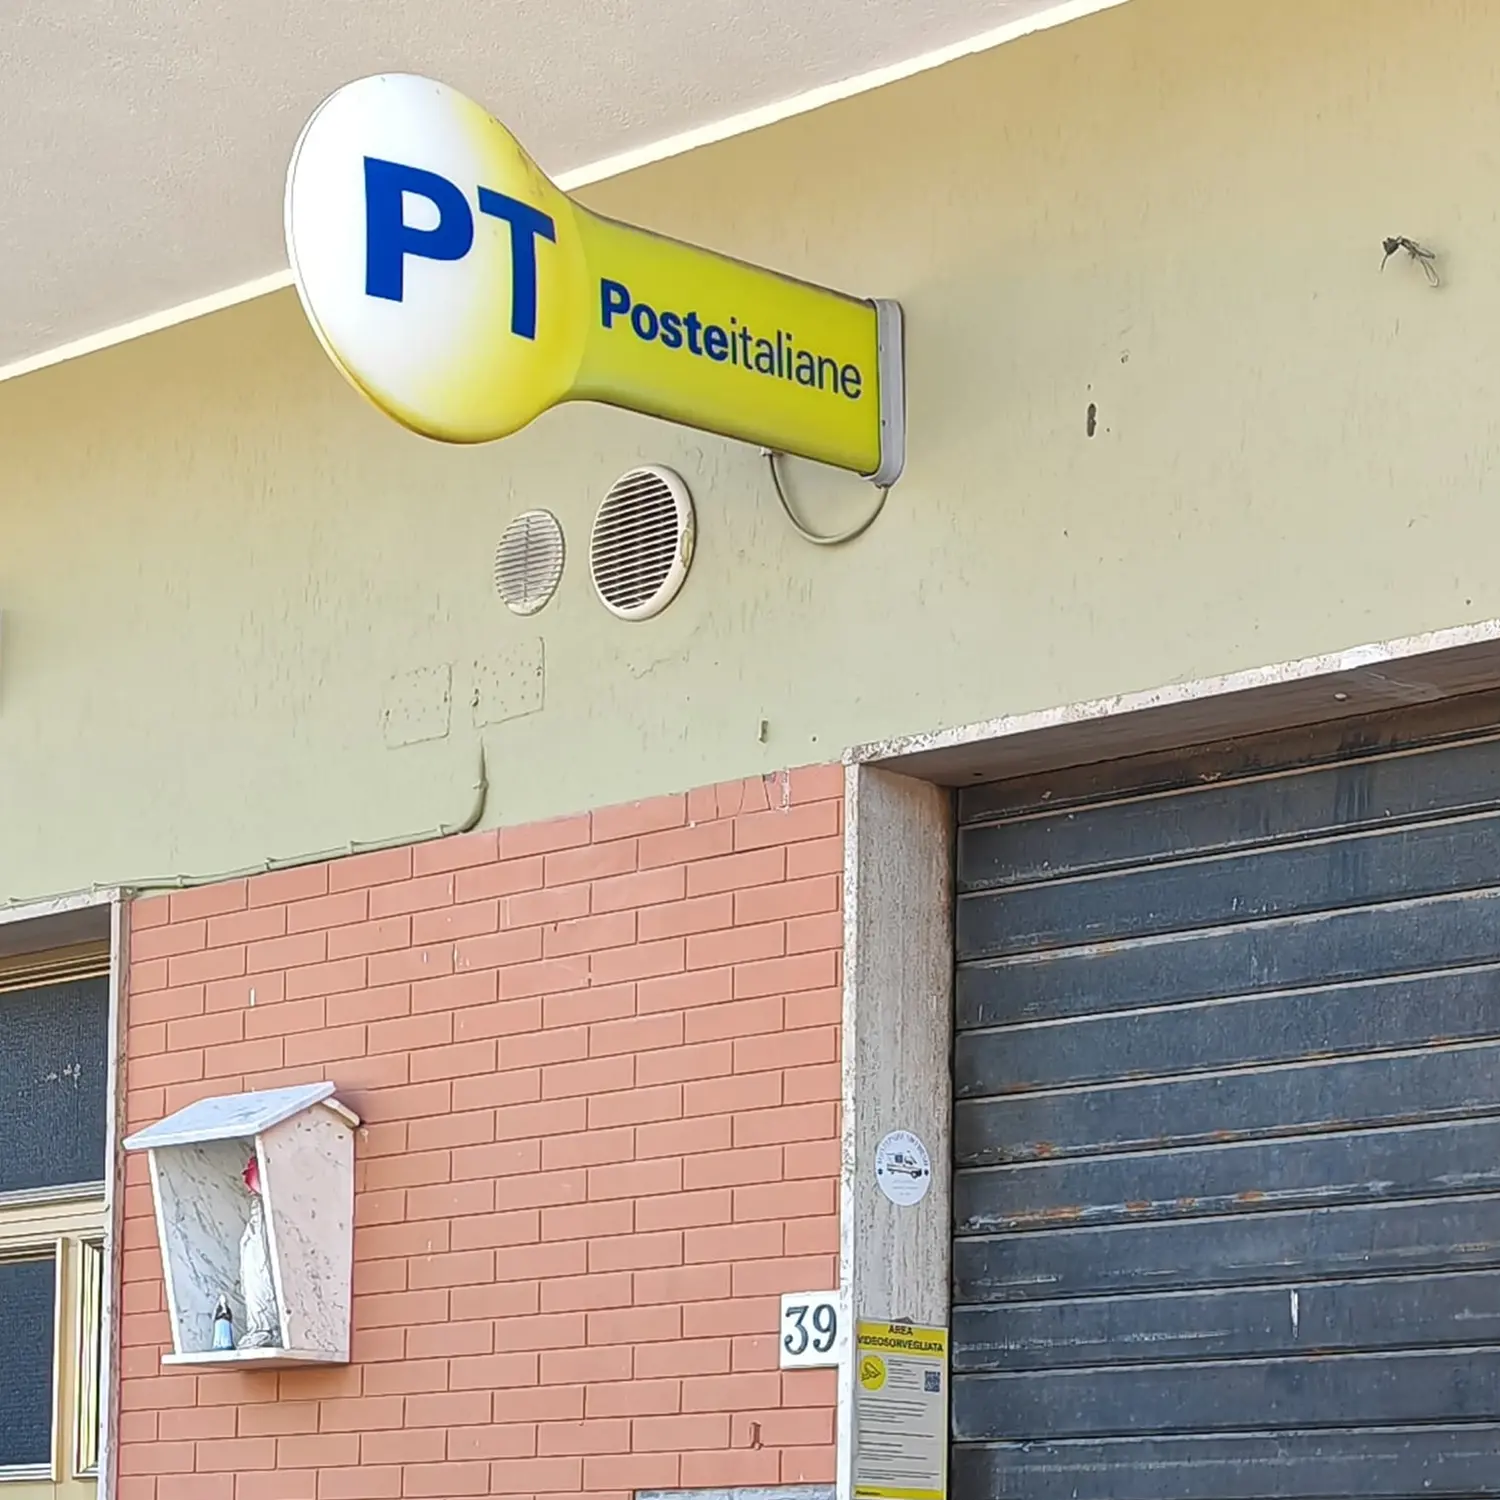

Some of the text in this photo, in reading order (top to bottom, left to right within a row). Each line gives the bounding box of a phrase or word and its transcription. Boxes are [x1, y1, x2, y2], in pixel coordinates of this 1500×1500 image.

[362, 155, 556, 341] PT
[600, 278, 862, 399] Posteitaliane
[784, 1304, 837, 1355] 39
[857, 1334, 944, 1352] VIDEOSORVEGLIATA
[888, 1324, 913, 1336] AREA
